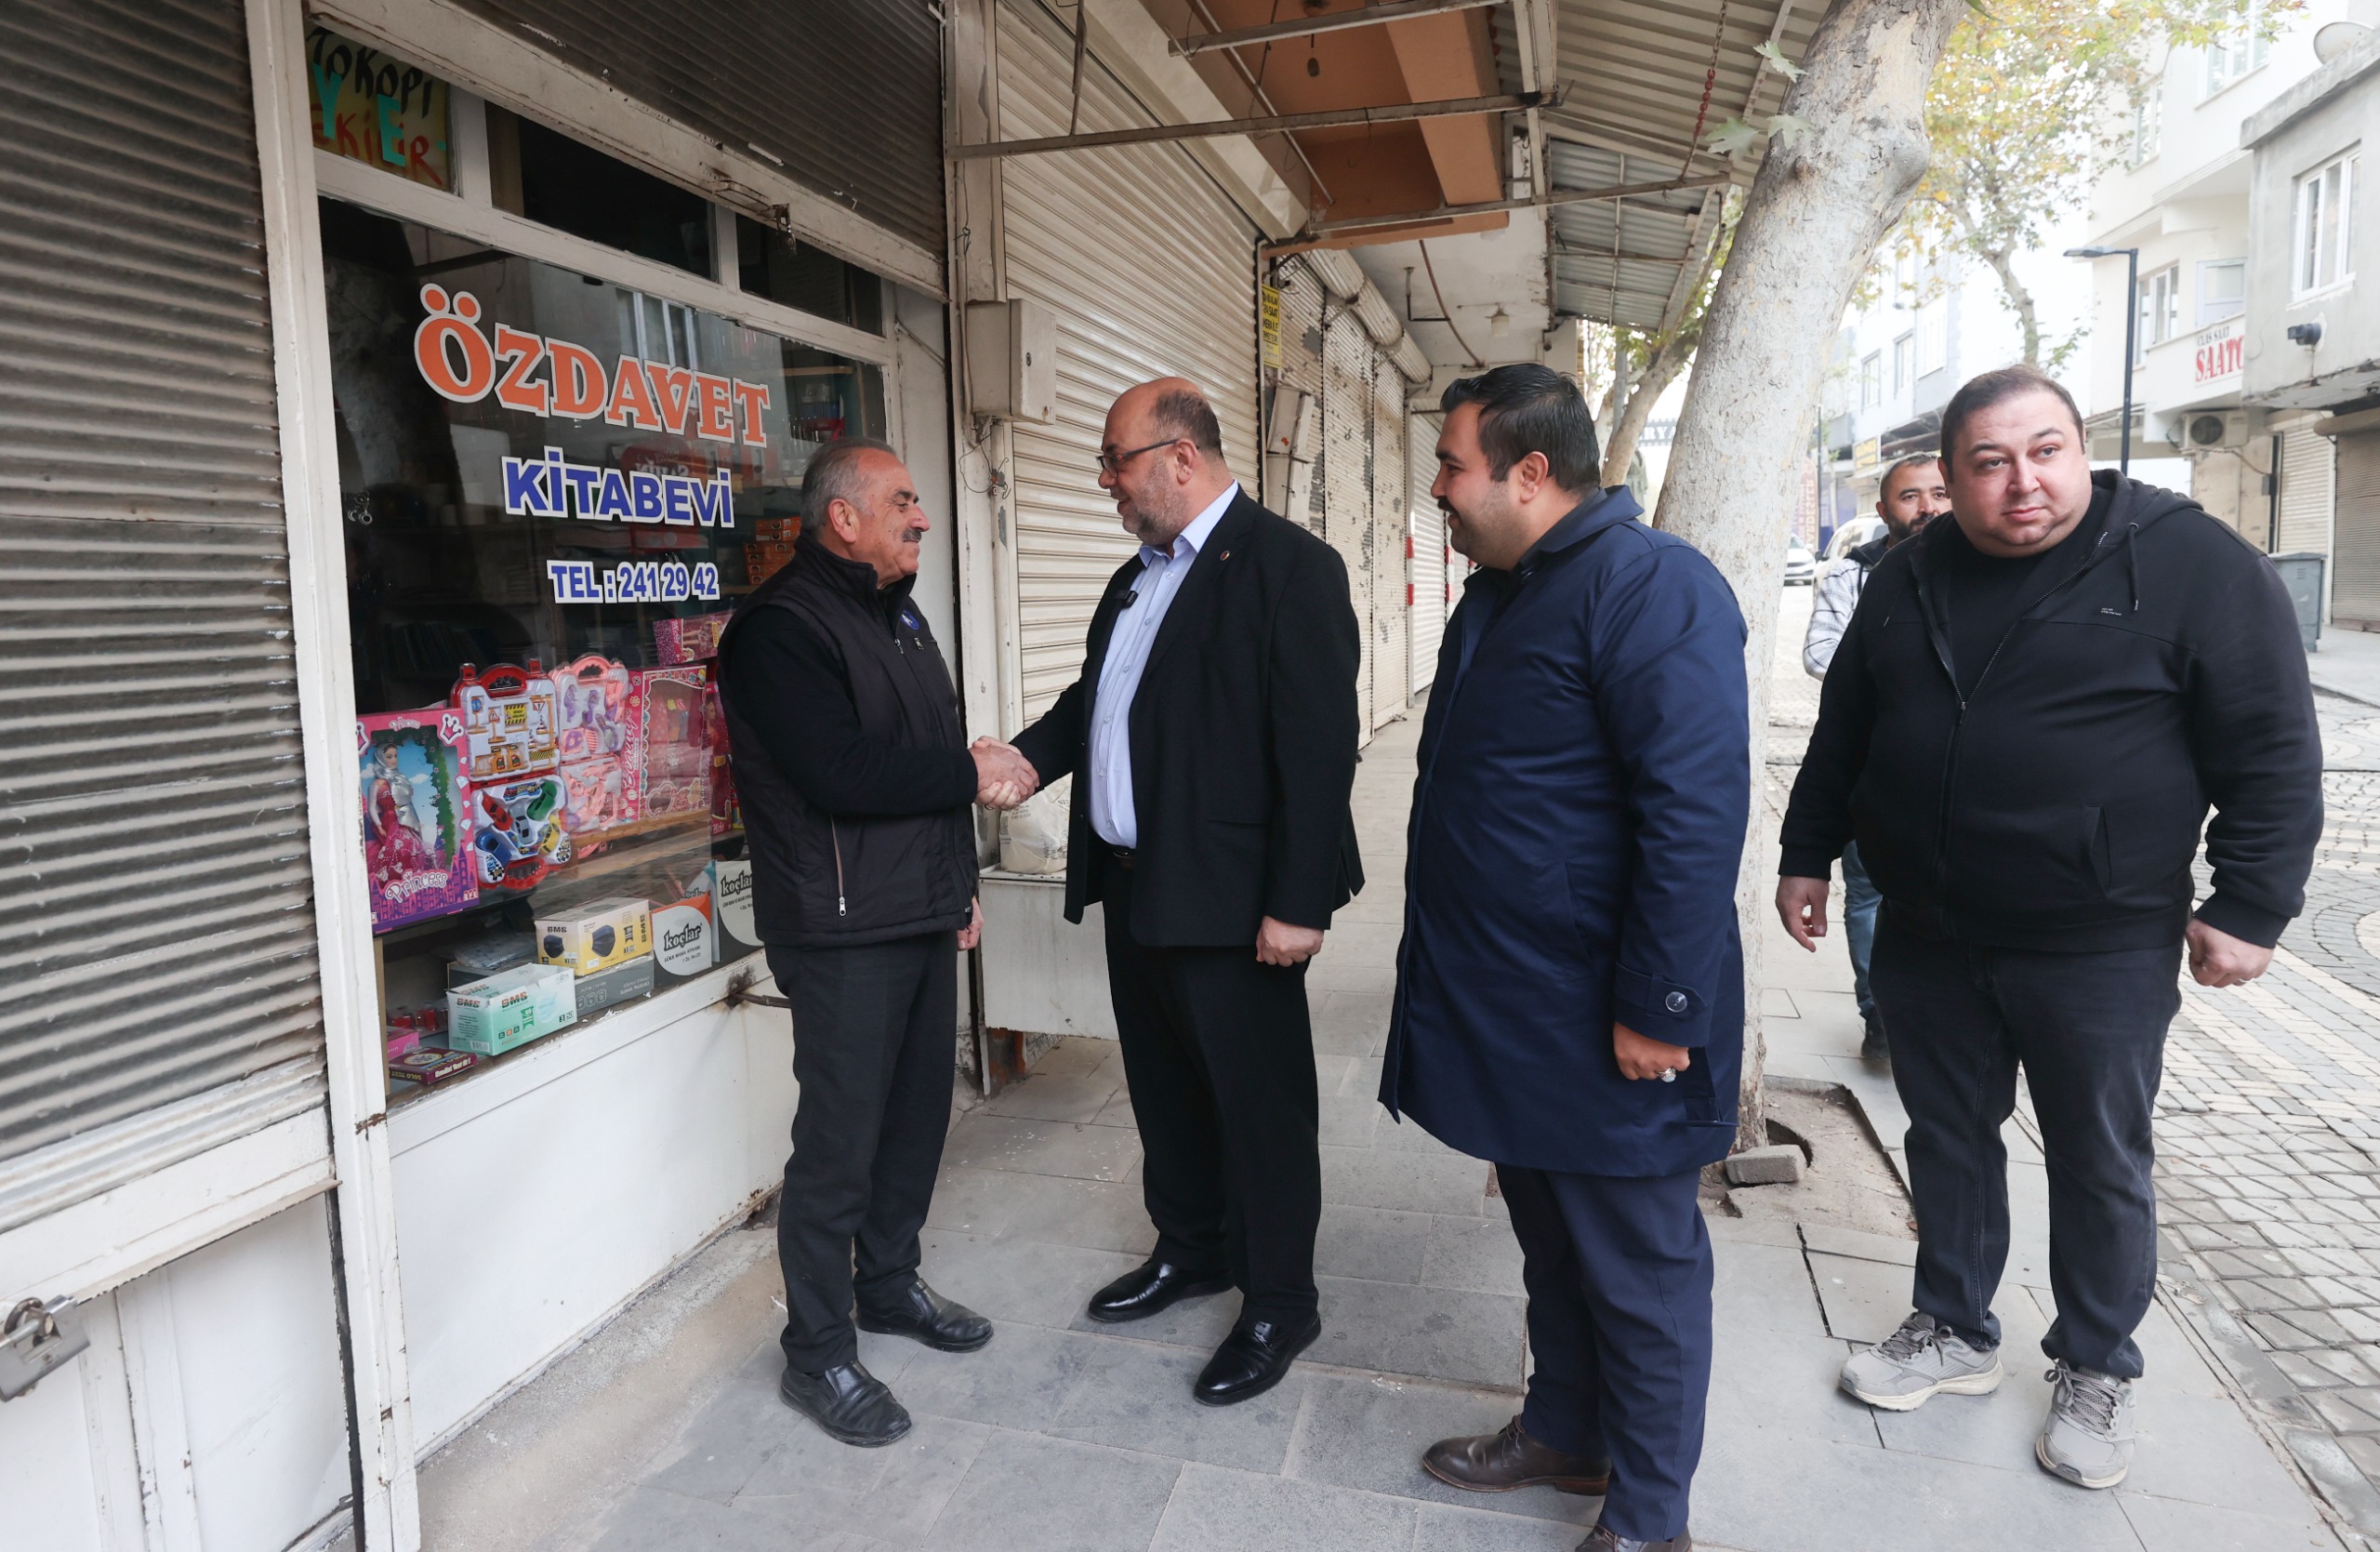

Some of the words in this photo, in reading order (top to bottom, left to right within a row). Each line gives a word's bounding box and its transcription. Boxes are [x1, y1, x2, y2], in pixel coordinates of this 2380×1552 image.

[415, 284, 770, 447] ÖZDAVET
[501, 445, 734, 527] KİTABEVİ
[617, 562, 660, 603] 241
[661, 563, 690, 602] 29
[692, 562, 720, 600] 42
[385, 872, 448, 902] Princess
[663, 923, 702, 951] koçlar
[456, 997, 481, 1008] BMS
[502, 991, 527, 1008] BMS
